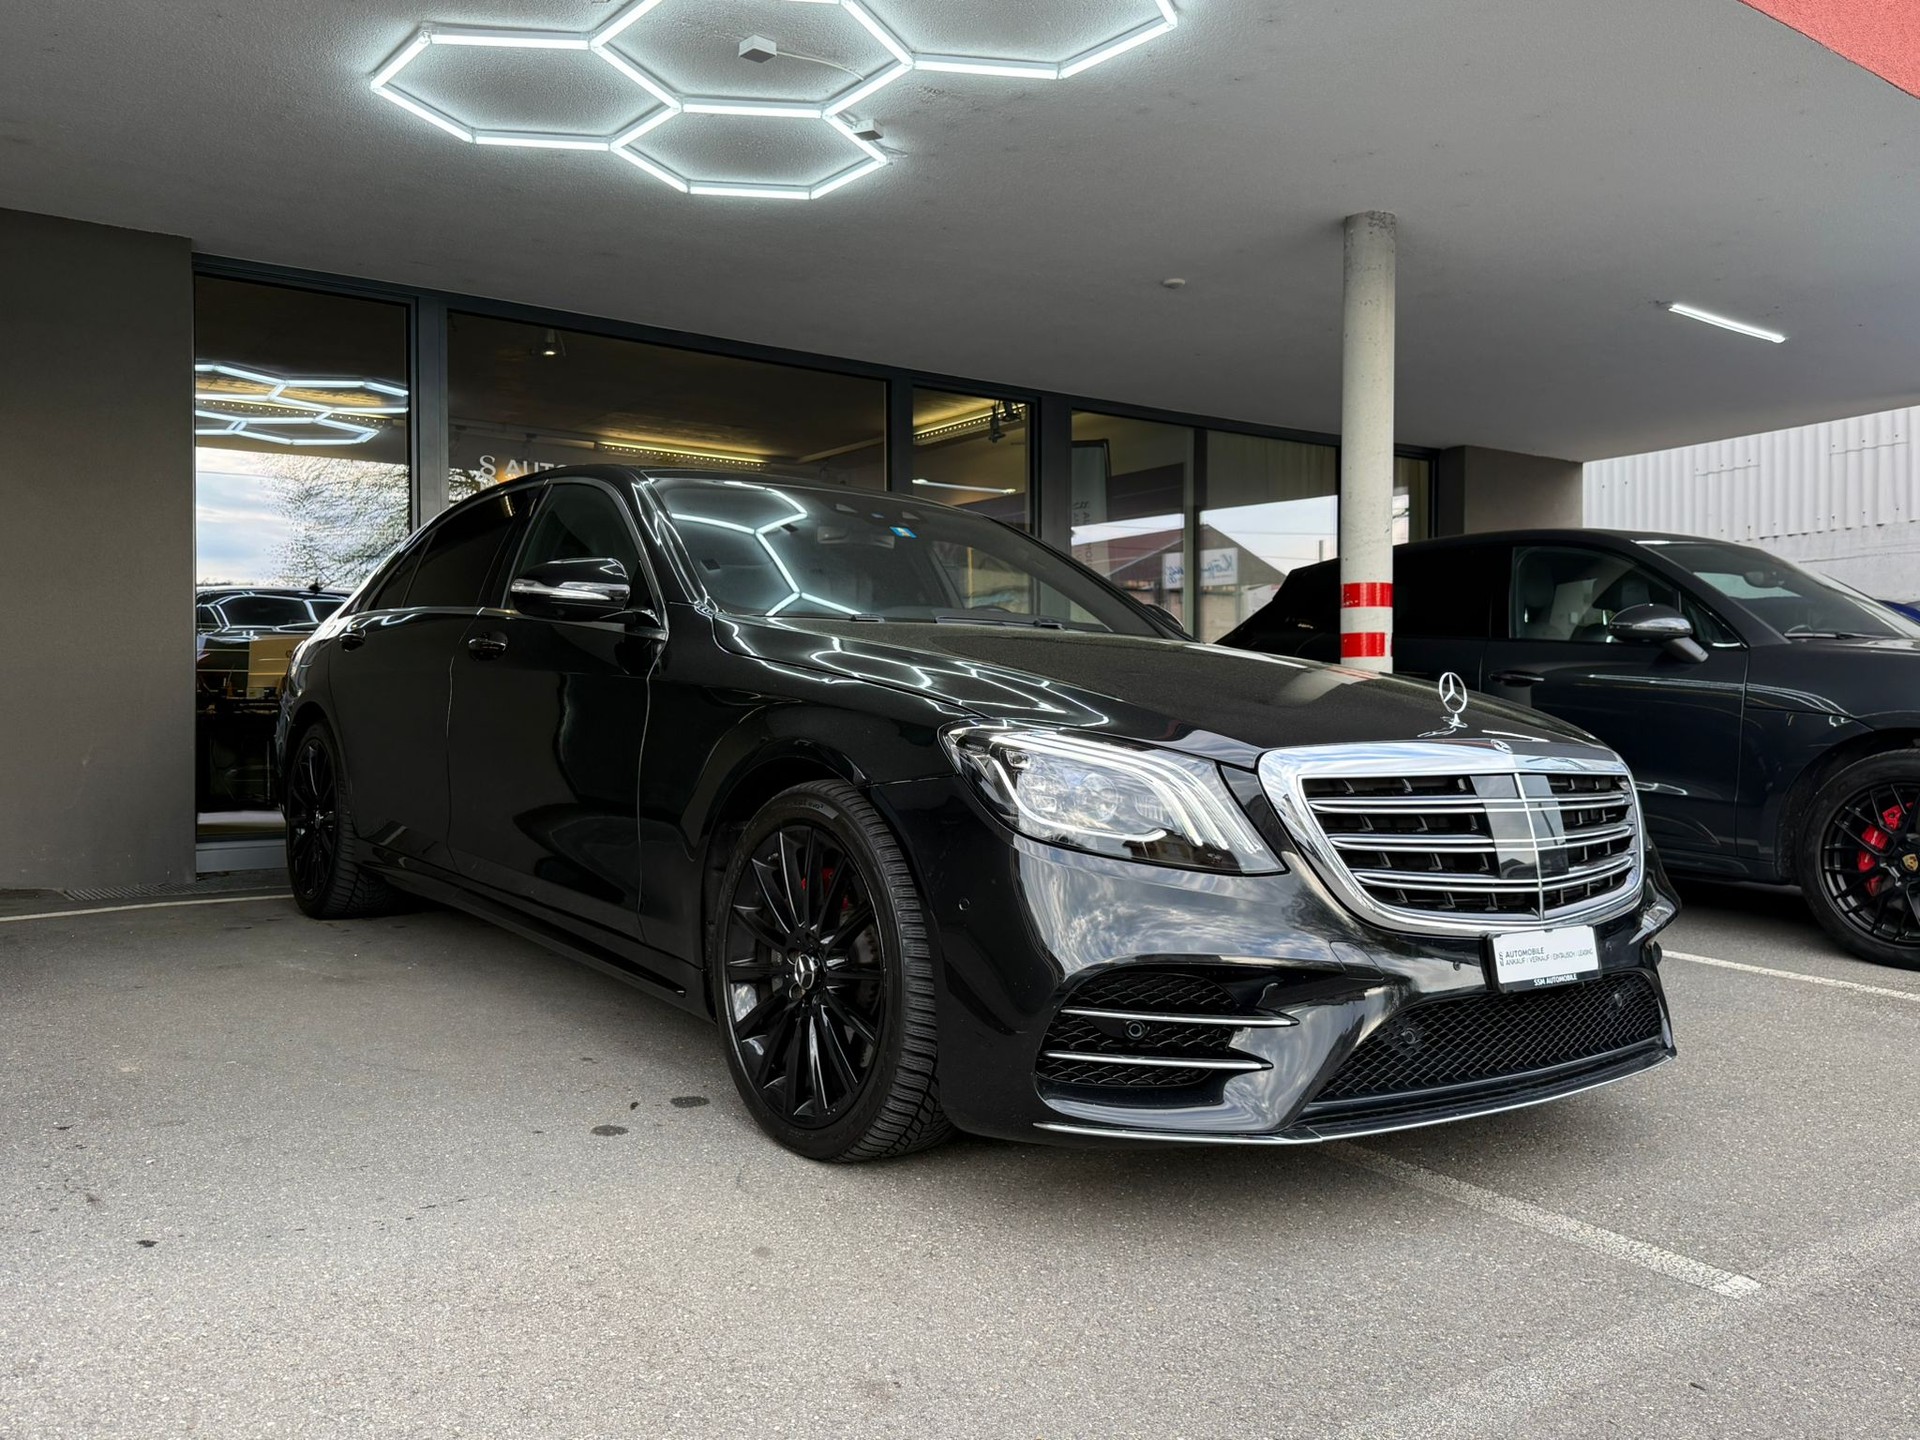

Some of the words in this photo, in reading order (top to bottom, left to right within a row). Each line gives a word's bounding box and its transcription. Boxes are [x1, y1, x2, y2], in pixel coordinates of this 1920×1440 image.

[505, 459, 567, 475] AUT
[1505, 947, 1544, 958] AUTOMOBILE
[1505, 956, 1525, 966] ANKAUF
[1529, 954, 1550, 963] VERKAUF
[1546, 973, 1578, 984] AUTOMOBILE
